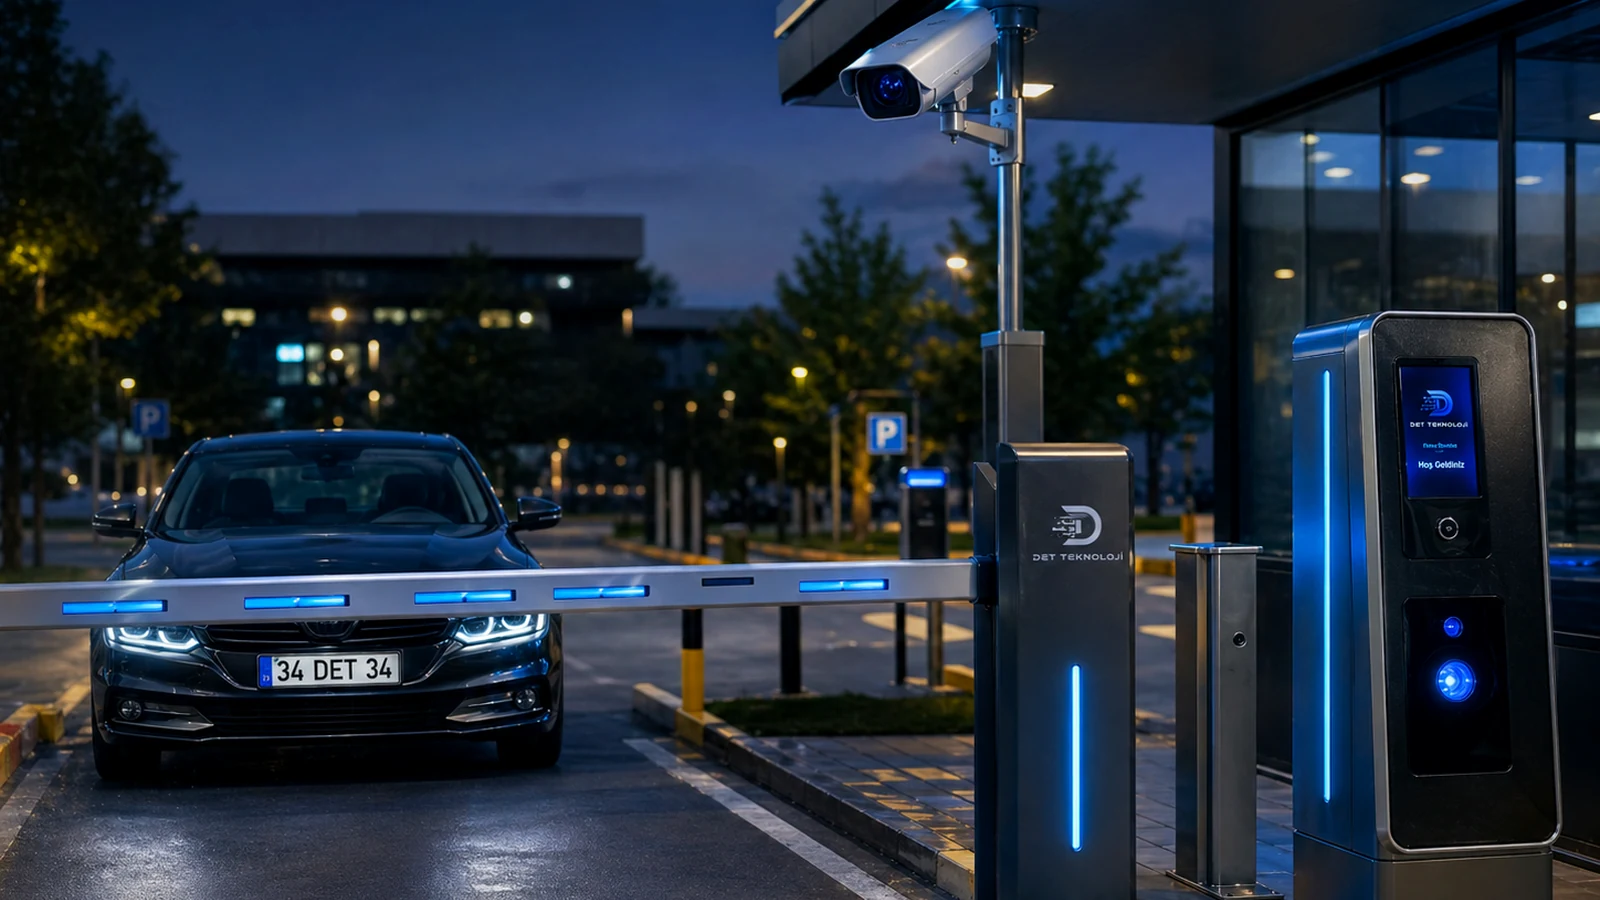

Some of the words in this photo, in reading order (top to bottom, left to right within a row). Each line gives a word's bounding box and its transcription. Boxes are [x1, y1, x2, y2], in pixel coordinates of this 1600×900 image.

[141, 405, 161, 434] P
[876, 419, 898, 448] P
[1032, 553, 1056, 561] DET
[277, 660, 304, 682] 34
[314, 658, 358, 681] DET
[366, 657, 392, 679] 34
